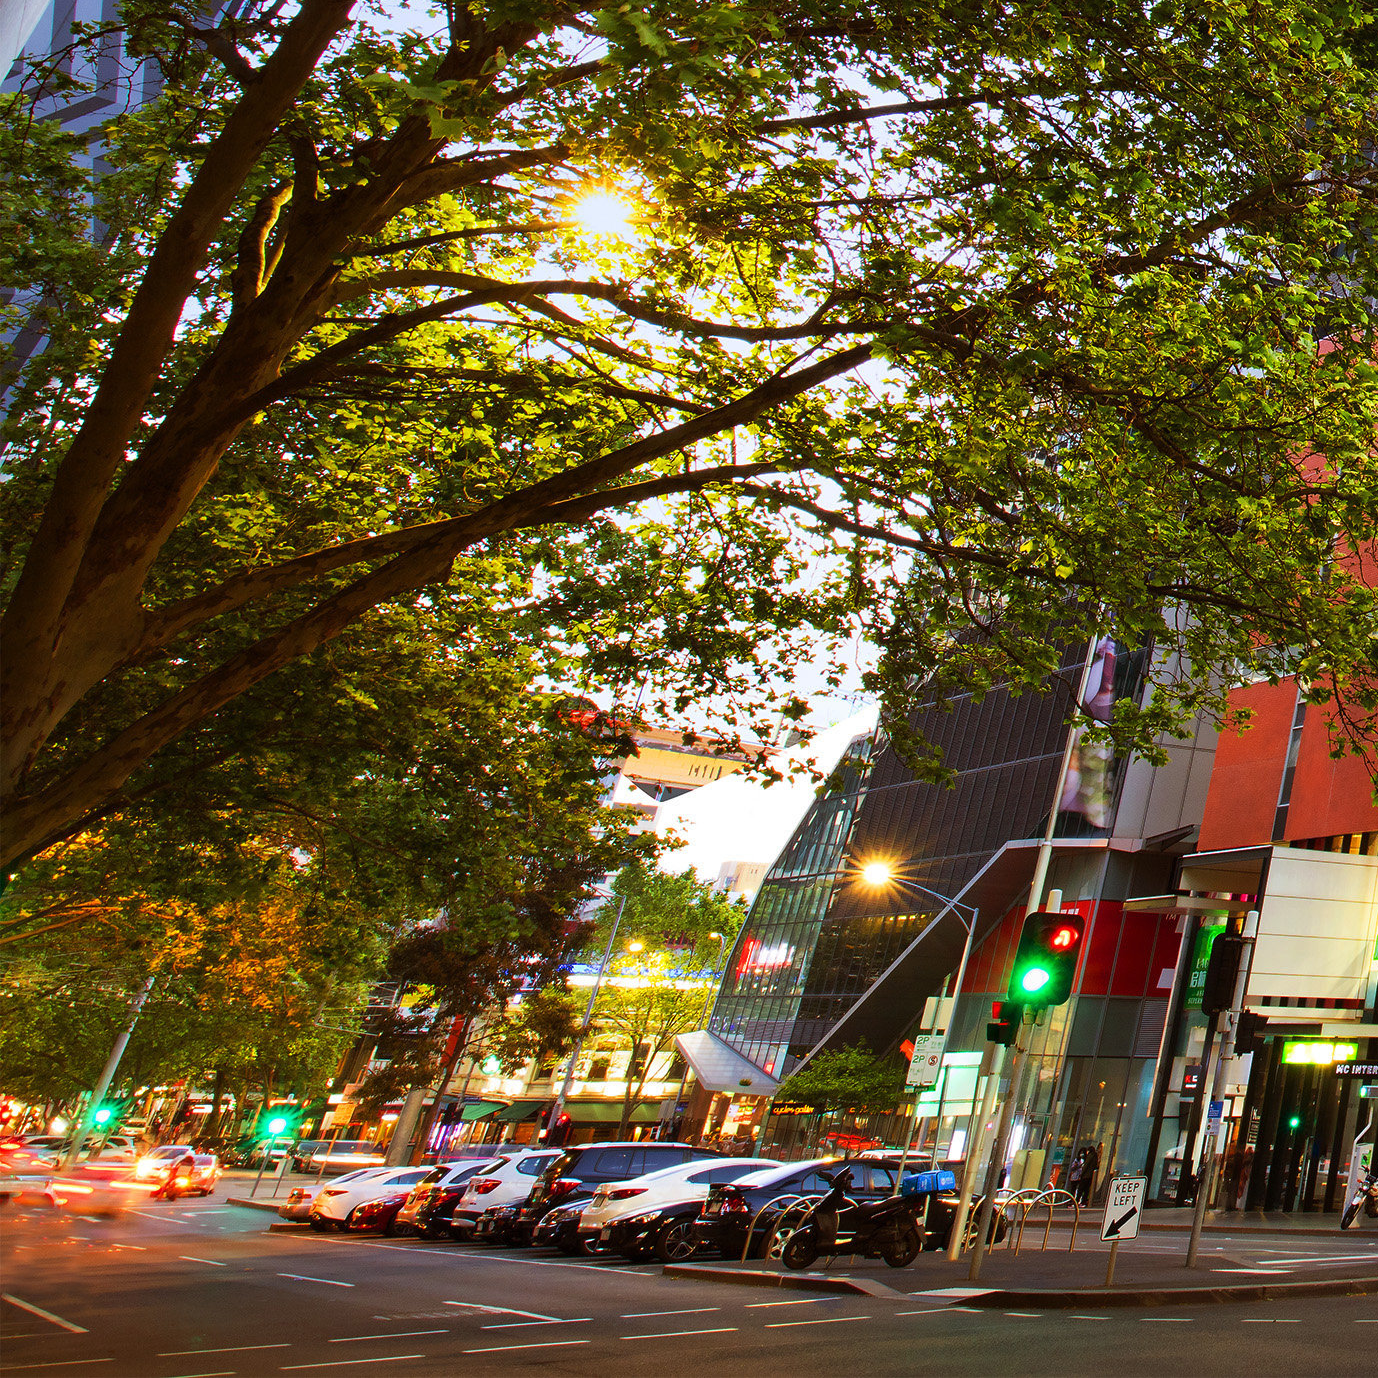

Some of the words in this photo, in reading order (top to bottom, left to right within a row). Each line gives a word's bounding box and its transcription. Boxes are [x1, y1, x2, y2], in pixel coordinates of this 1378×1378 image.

[917, 1037, 929, 1045] 2P
[912, 1055, 925, 1063] 2P
[1336, 1064, 1350, 1075] MC
[1115, 1183, 1140, 1193] KEEP
[1113, 1195, 1137, 1206] LEFT
